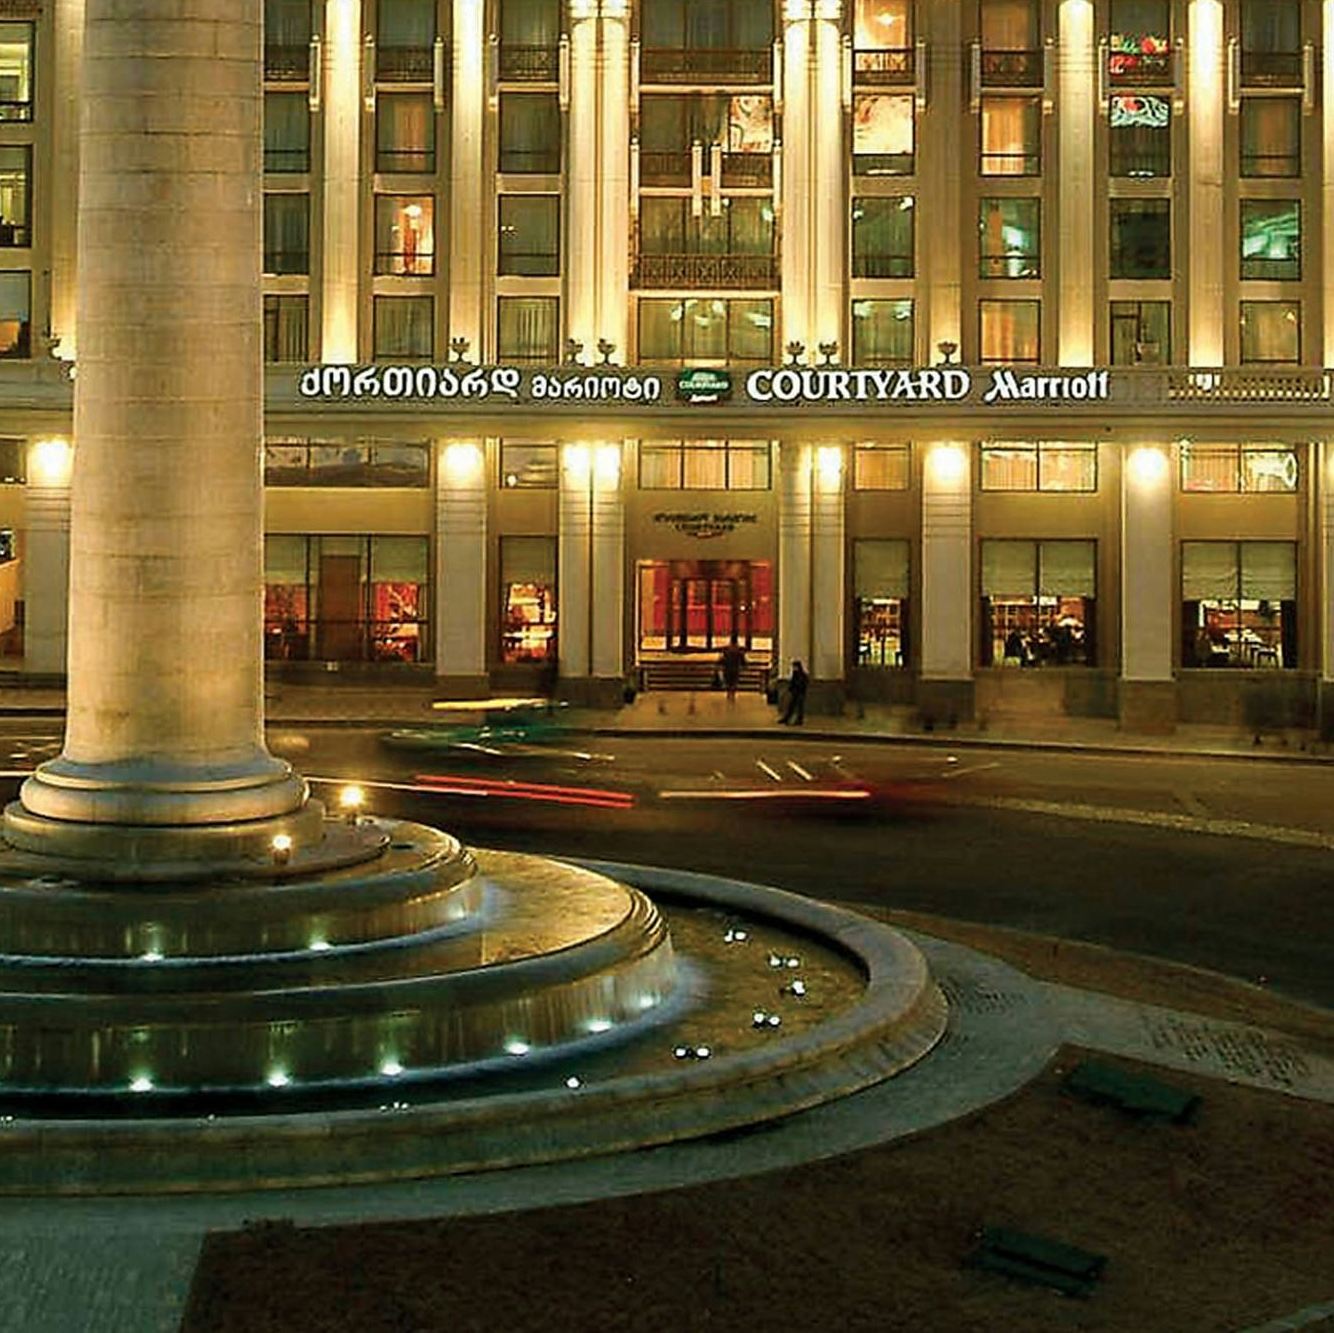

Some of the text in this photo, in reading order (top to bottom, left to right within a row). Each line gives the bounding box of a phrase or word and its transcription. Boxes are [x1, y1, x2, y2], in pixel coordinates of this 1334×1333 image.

[300, 367, 661, 399] ქორთიარდ მარიოტი
[746, 369, 1109, 402] COURTYARD Marriott
